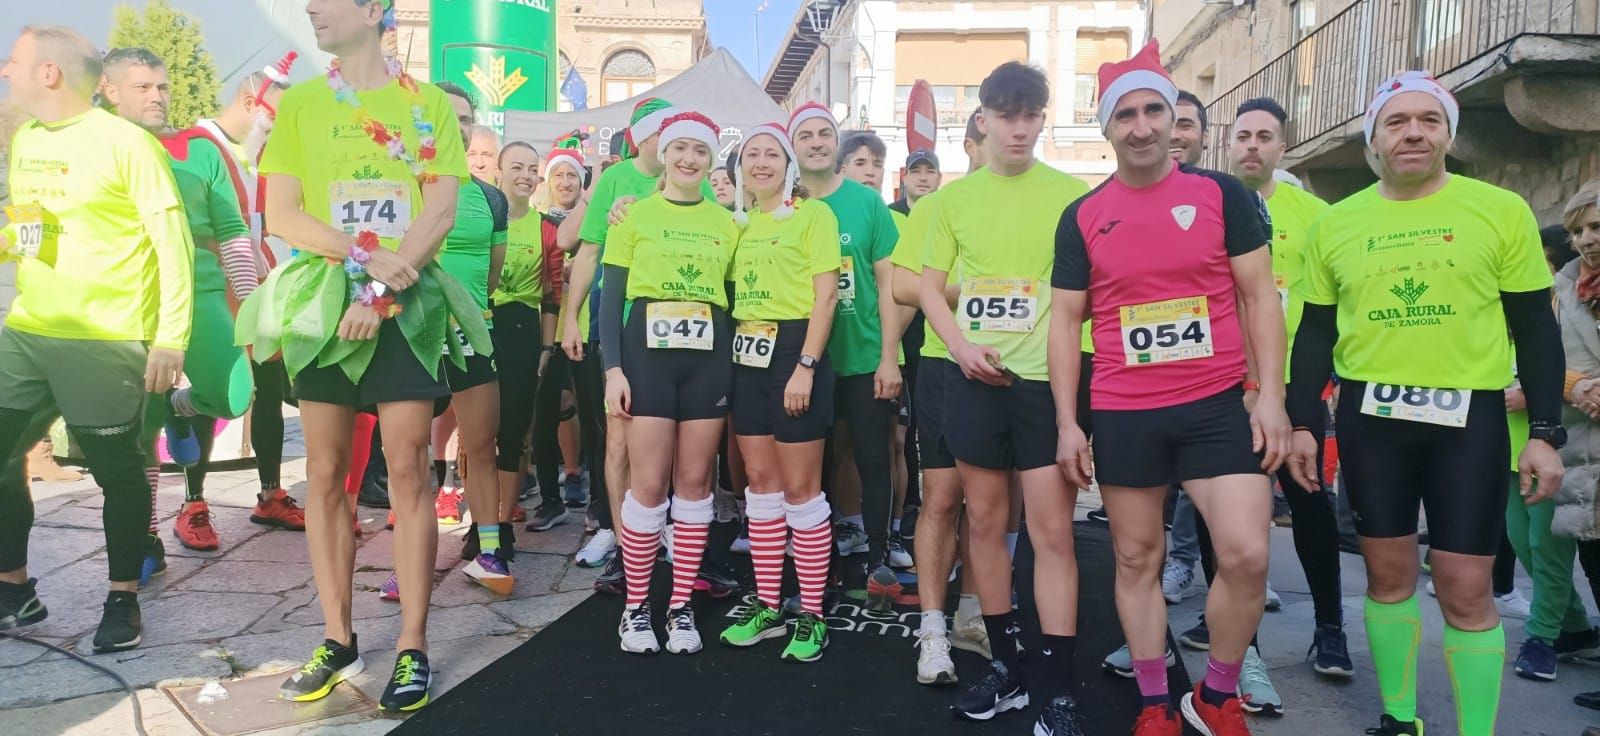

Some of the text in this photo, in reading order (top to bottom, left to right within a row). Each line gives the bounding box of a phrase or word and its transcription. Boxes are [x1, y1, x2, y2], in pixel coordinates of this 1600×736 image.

[342, 199, 397, 224] 174
[20, 223, 41, 246] 027
[1387, 232, 1406, 241] SAN
[1408, 227, 1454, 238] SILVESTRE
[662, 282, 718, 296] CAJA RURAL
[735, 290, 774, 301] AJA RURAL
[966, 297, 1030, 320] 055
[1368, 304, 1457, 321] CAJA RURAL
[652, 319, 708, 338] 047
[1398, 317, 1442, 327] ZAMORA
[735, 334, 770, 357] 076
[1129, 320, 1205, 351] 054
[1373, 383, 1462, 412] 080
